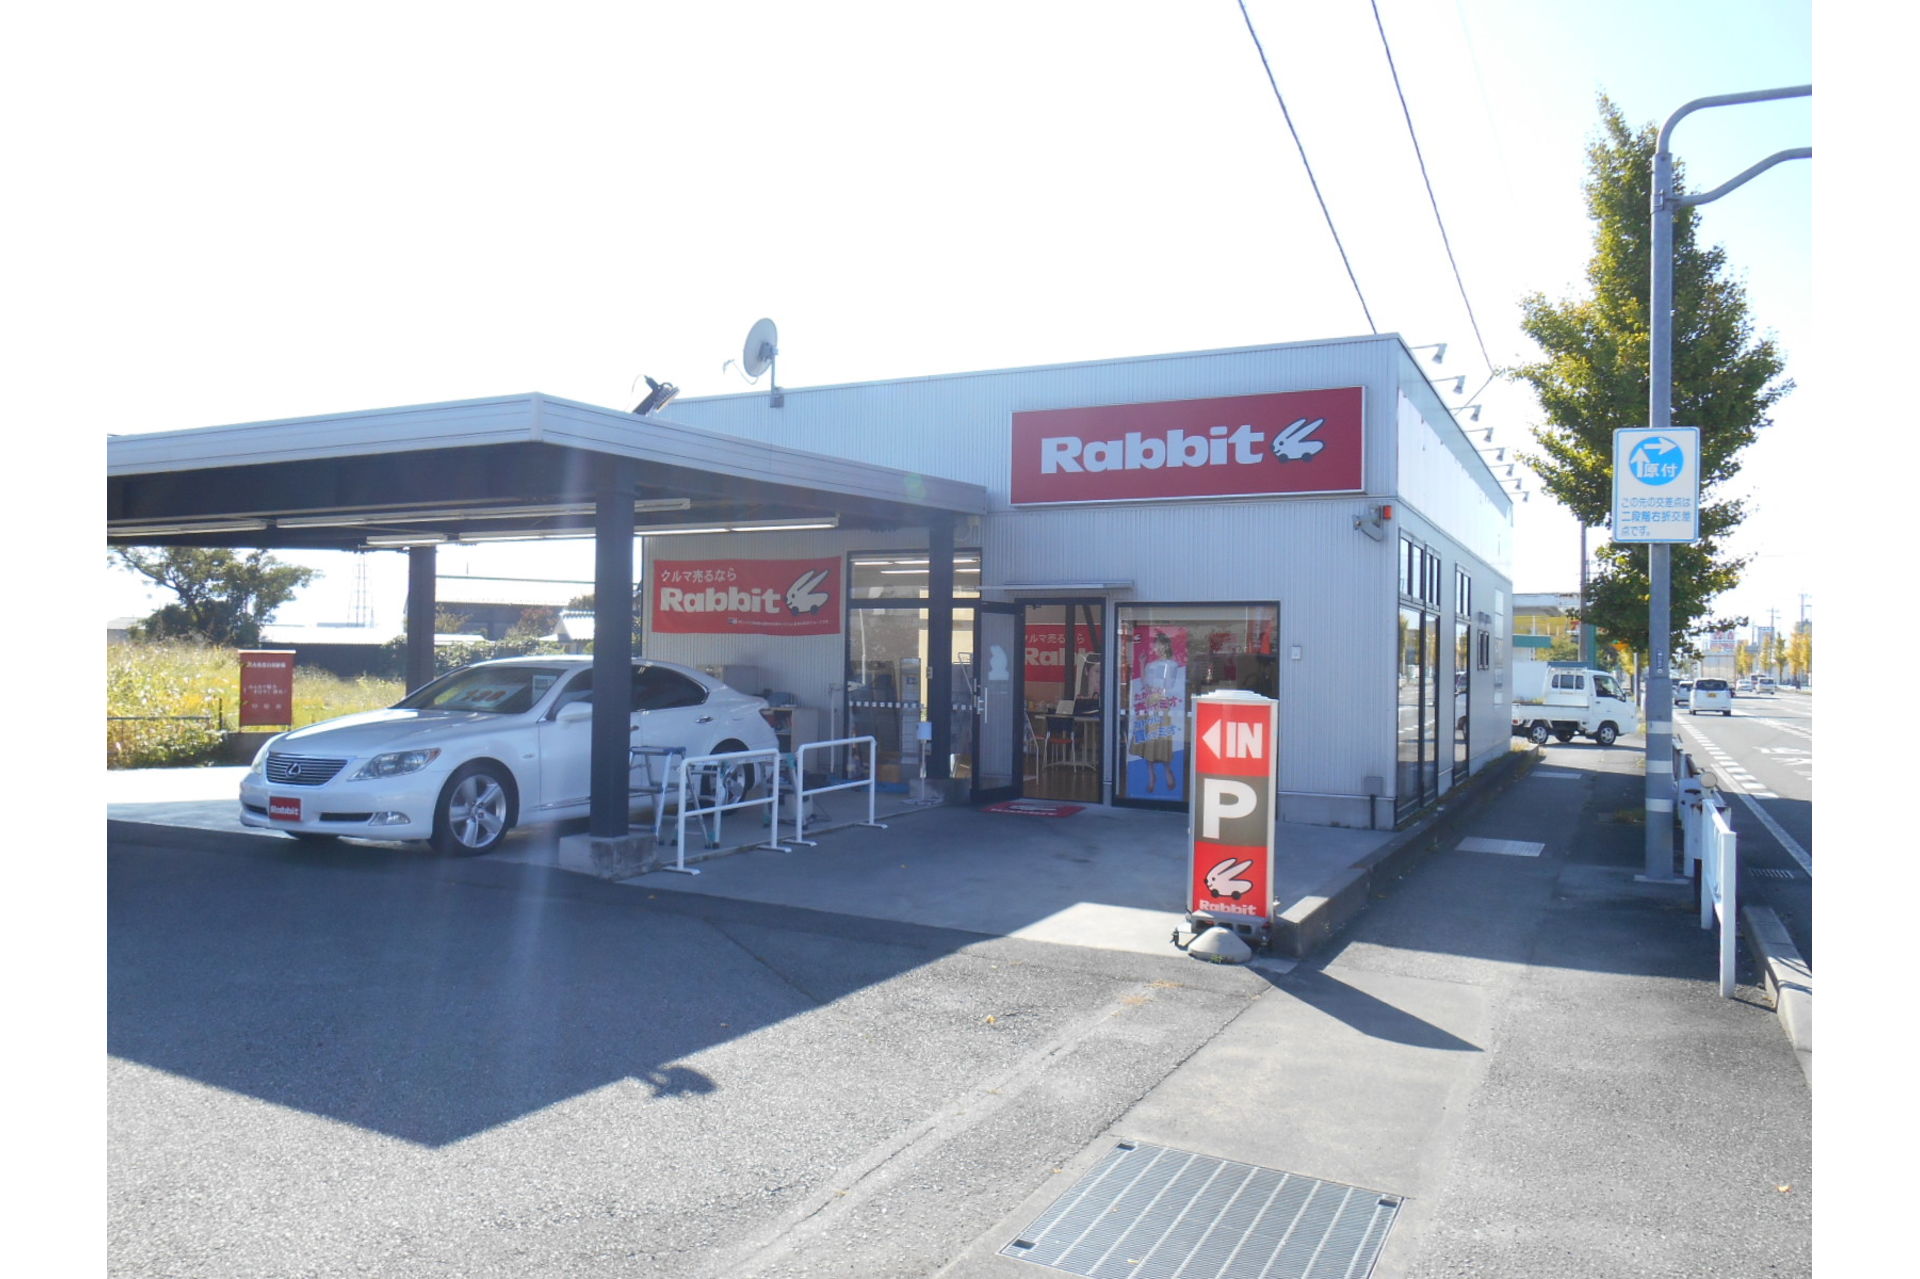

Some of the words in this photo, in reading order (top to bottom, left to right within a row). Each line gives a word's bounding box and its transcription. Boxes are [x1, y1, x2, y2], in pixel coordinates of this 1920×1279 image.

[1041, 425, 1264, 475] Rabbit
[1643, 463, 1678, 477] 原付
[660, 568, 737, 583] クルマ売るなら
[660, 587, 781, 614] Rabbit
[1226, 723, 1264, 759] IN
[1202, 778, 1258, 840] P
[1199, 899, 1257, 916] Rabbit
